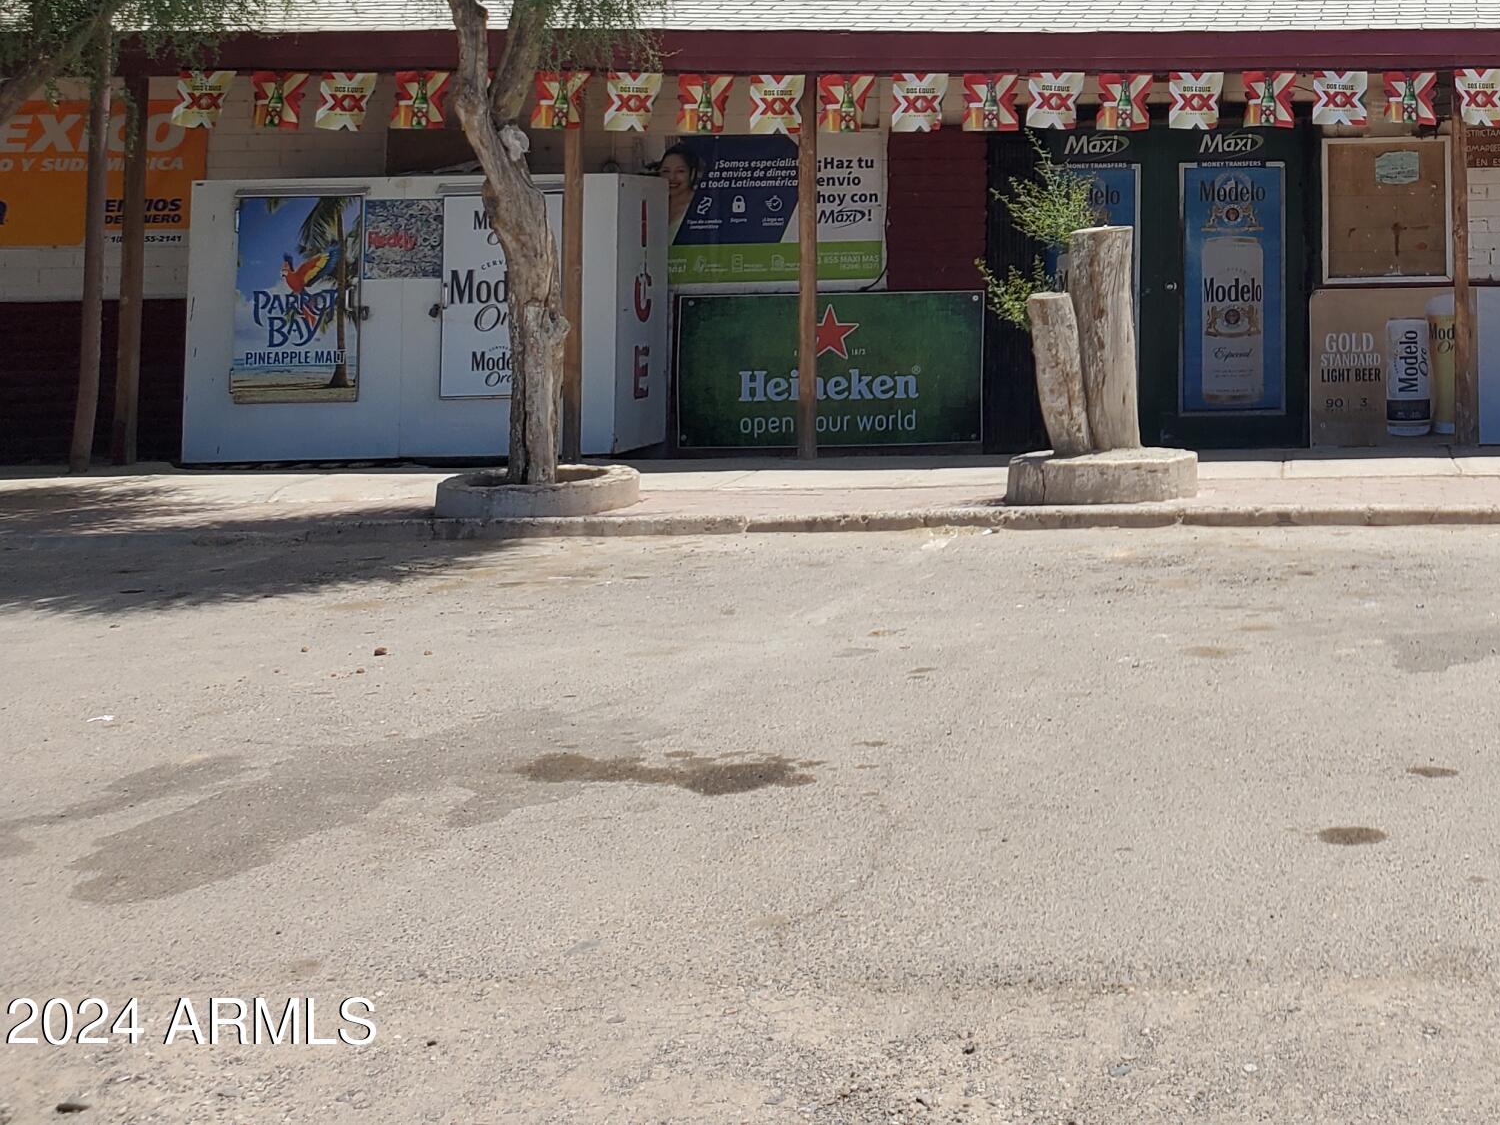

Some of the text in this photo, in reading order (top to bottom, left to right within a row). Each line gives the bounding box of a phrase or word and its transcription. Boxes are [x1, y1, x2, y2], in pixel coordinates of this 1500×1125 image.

[185, 93, 224, 110] XX
[328, 94, 367, 112] XX
[615, 94, 652, 112] XX
[760, 98, 796, 115] XX
[902, 96, 939, 113] XX
[1036, 92, 1073, 111] XX
[1178, 94, 1214, 111] XX
[1322, 91, 1359, 108] XX
[1463, 90, 1499, 108] XX
[1064, 134, 1119, 154] Maxi
[1200, 134, 1252, 153] Maxi
[22, 158, 36, 171] Y
[715, 157, 798, 170] ¡Somos especialist
[817, 157, 874, 172] ¡Haz tu
[1476, 158, 1488, 166] EN
[721, 168, 752, 178] envíos
[753, 168, 766, 177] de
[766, 168, 797, 177] dinero
[817, 172, 861, 186] envío
[708, 179, 730, 188] toda
[1200, 179, 1265, 203] Modelo
[851, 193, 879, 204] con
[450, 269, 508, 304] Mod
[1204, 277, 1262, 303] Modelo
[253, 289, 338, 326] PARROT
[635, 200, 652, 400] ICE
[267, 305, 328, 347] BAY
[1325, 332, 1374, 353] GOLD
[245, 350, 346, 365] PINEAPPLE MALT
[471, 351, 513, 372] Mode
[1321, 354, 1381, 367] STANDARD
[1398, 330, 1419, 393] Modelo
[1321, 368, 1381, 383] LIGHT BEER
[1326, 398, 1344, 408] 90
[740, 409, 917, 438] open our world
